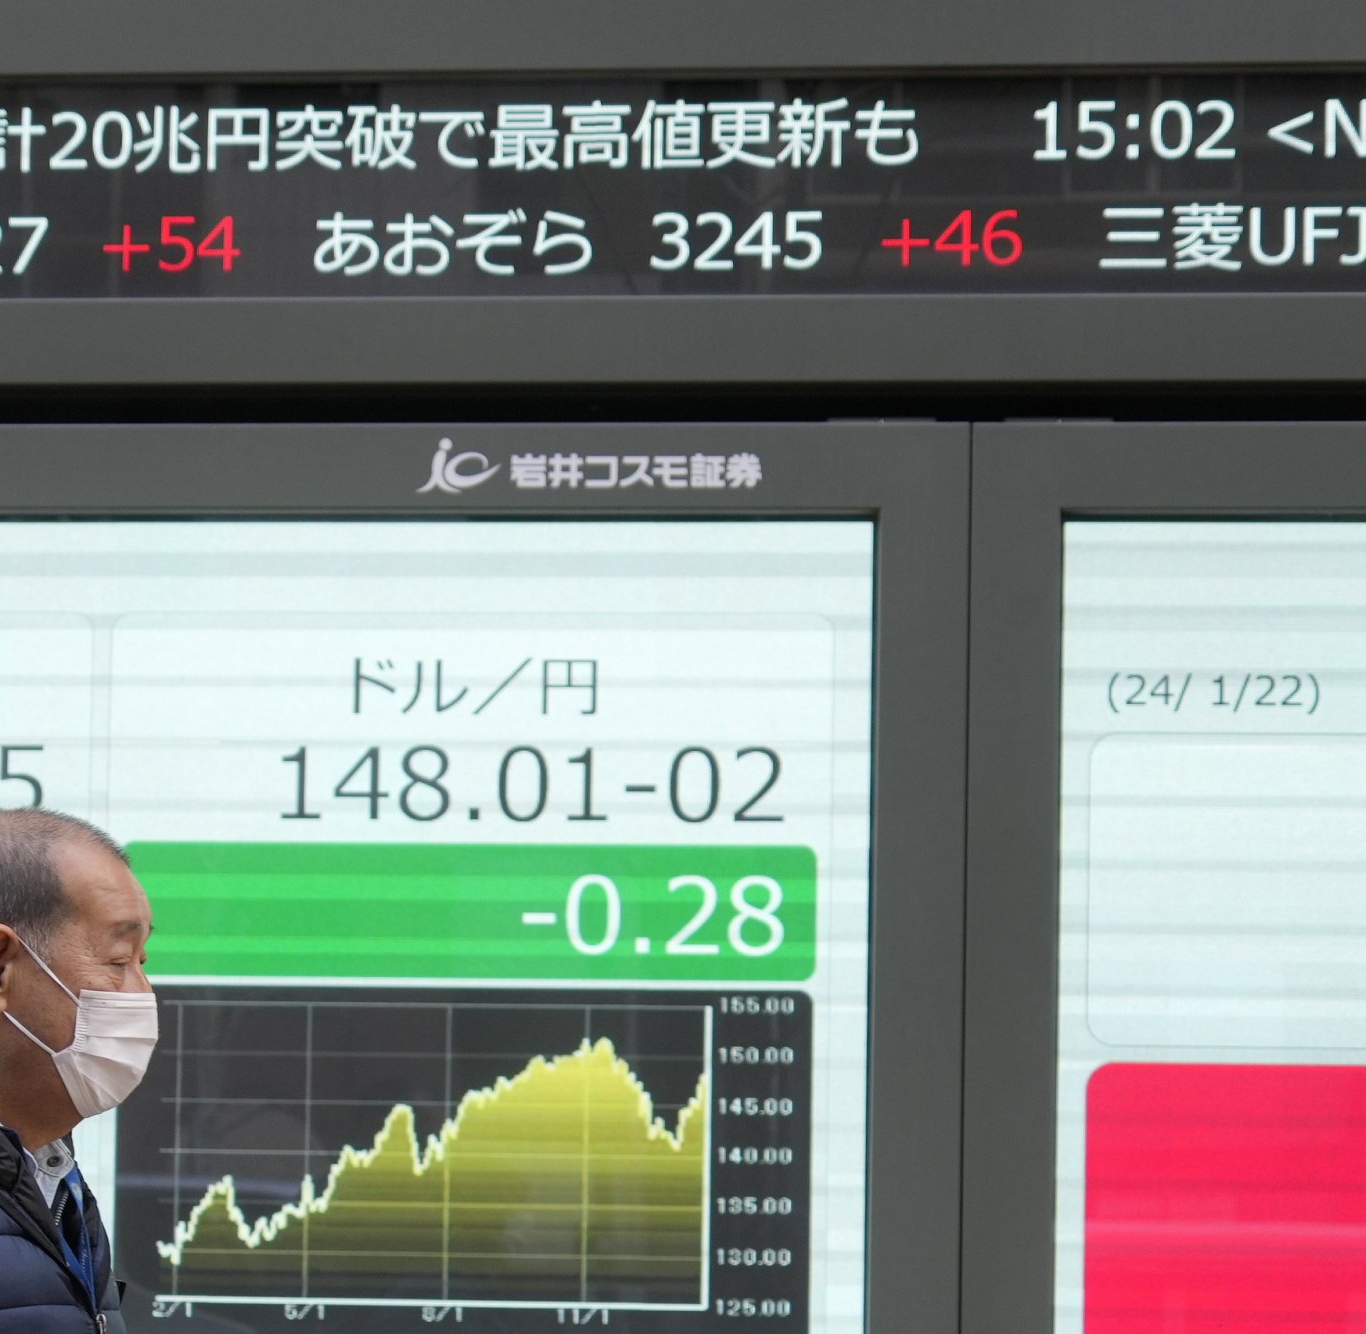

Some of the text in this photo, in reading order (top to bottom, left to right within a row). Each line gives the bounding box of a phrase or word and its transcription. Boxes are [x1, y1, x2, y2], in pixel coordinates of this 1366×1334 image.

[1033, 99, 1236, 160] 15:02
[103, 215, 242, 273] +54
[313, 207, 593, 276] あおぞら
[650, 210, 823, 270] 3245
[881, 209, 1024, 268] +46
[510, 452, 763, 489] 岩井コスモ証券
[281, 745, 784, 824] 148.01-02
[522, 874, 784, 957] -0.28
[720, 996, 795, 1015] 155.00
[718, 1046, 794, 1064] 150.00
[718, 1097, 793, 1116] 145.00
[718, 1146, 793, 1165] 140.00
[717, 1196, 792, 1215] 135.00
[717, 1247, 792, 1267] 130.00
[151, 1302, 610, 1325] 2/1 5/1 8/1 11/1
[715, 1298, 791, 1317] 125.00
